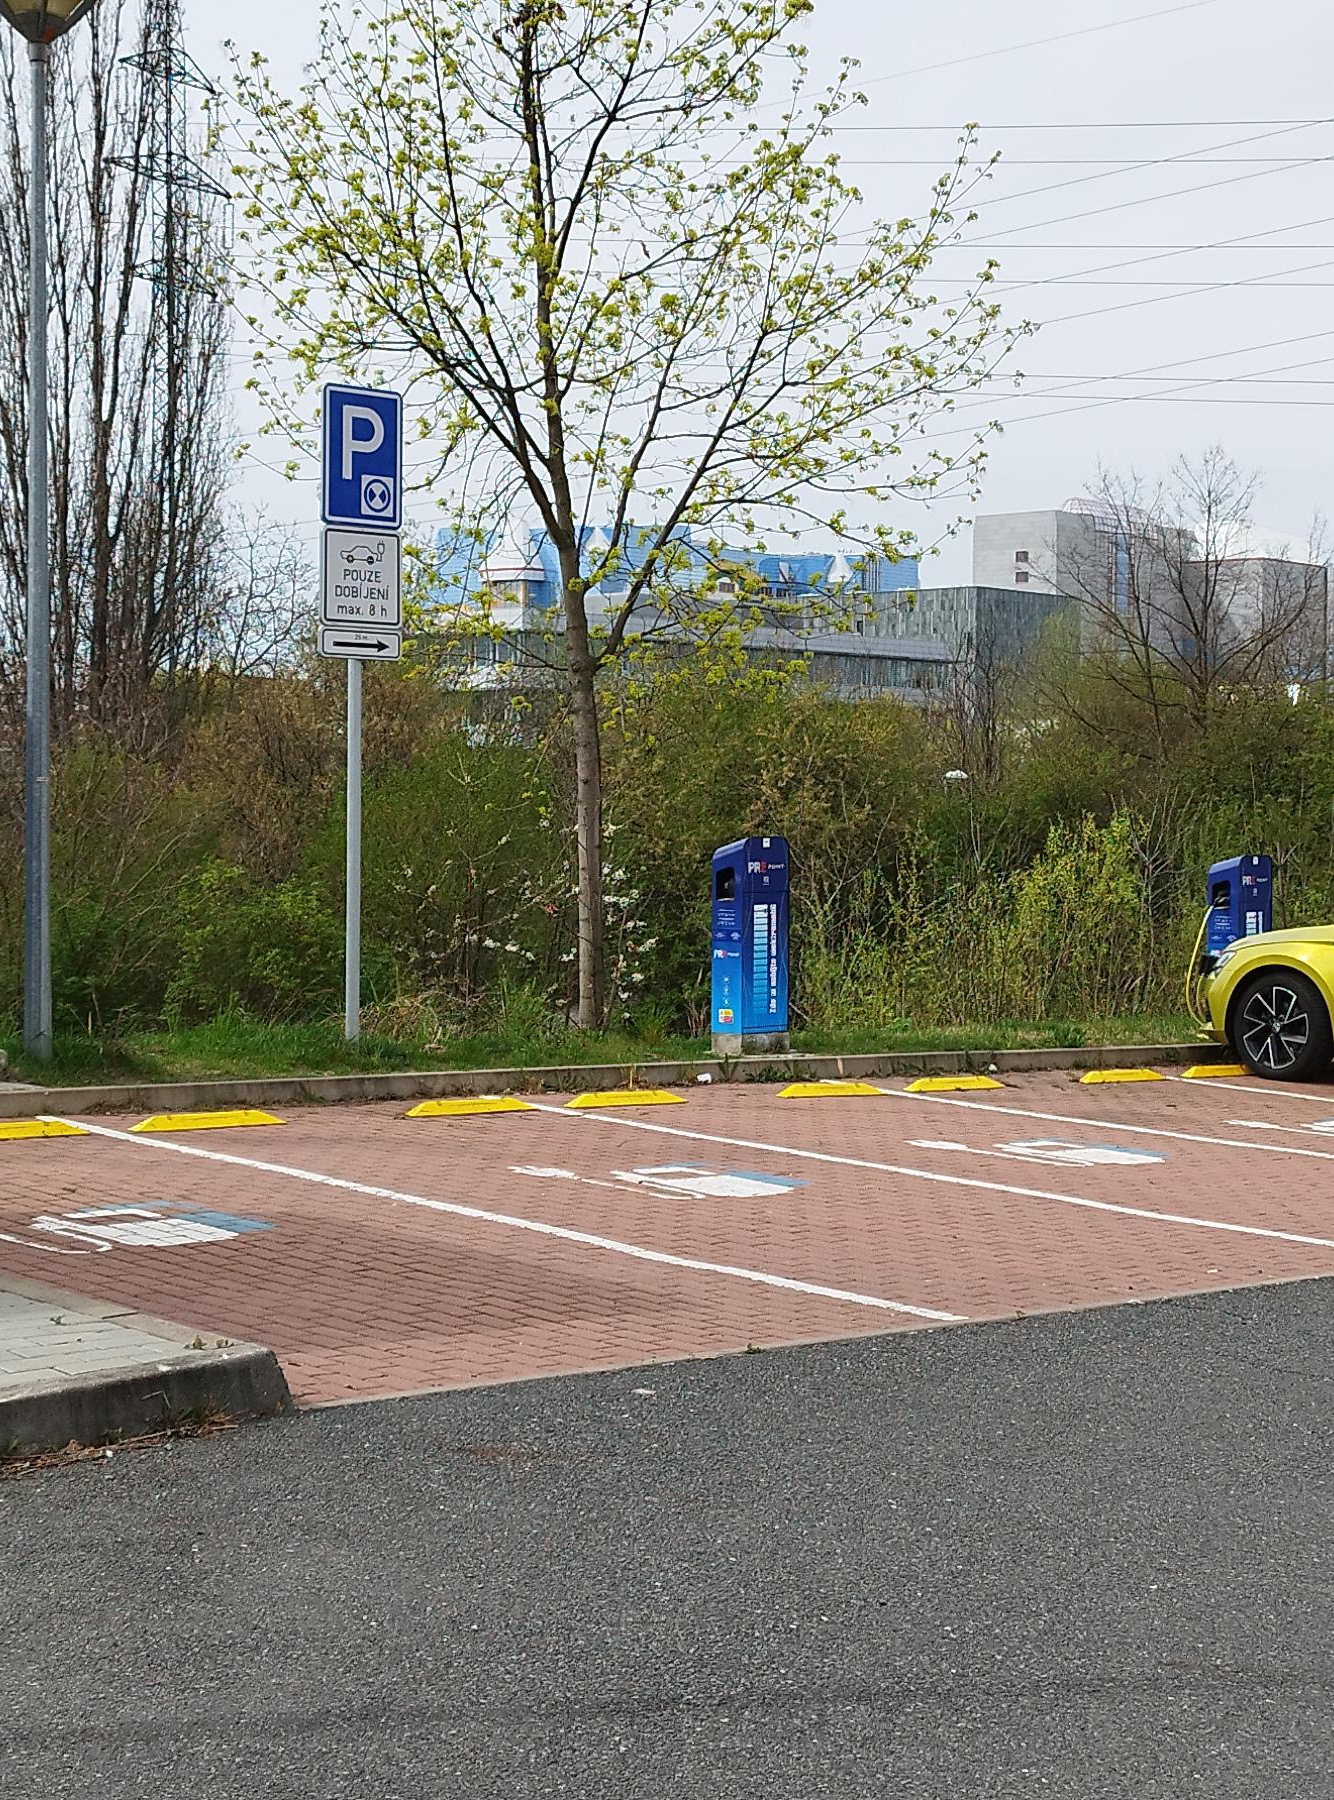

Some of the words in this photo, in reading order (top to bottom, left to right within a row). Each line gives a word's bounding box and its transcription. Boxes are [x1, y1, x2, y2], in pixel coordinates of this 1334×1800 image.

[342, 404, 385, 480] P
[343, 568, 382, 583] POUZE
[334, 581, 390, 600] DOBÍJENÍ
[337, 604, 364, 616] max.
[369, 603, 376, 616] 8
[380, 604, 387, 617] h
